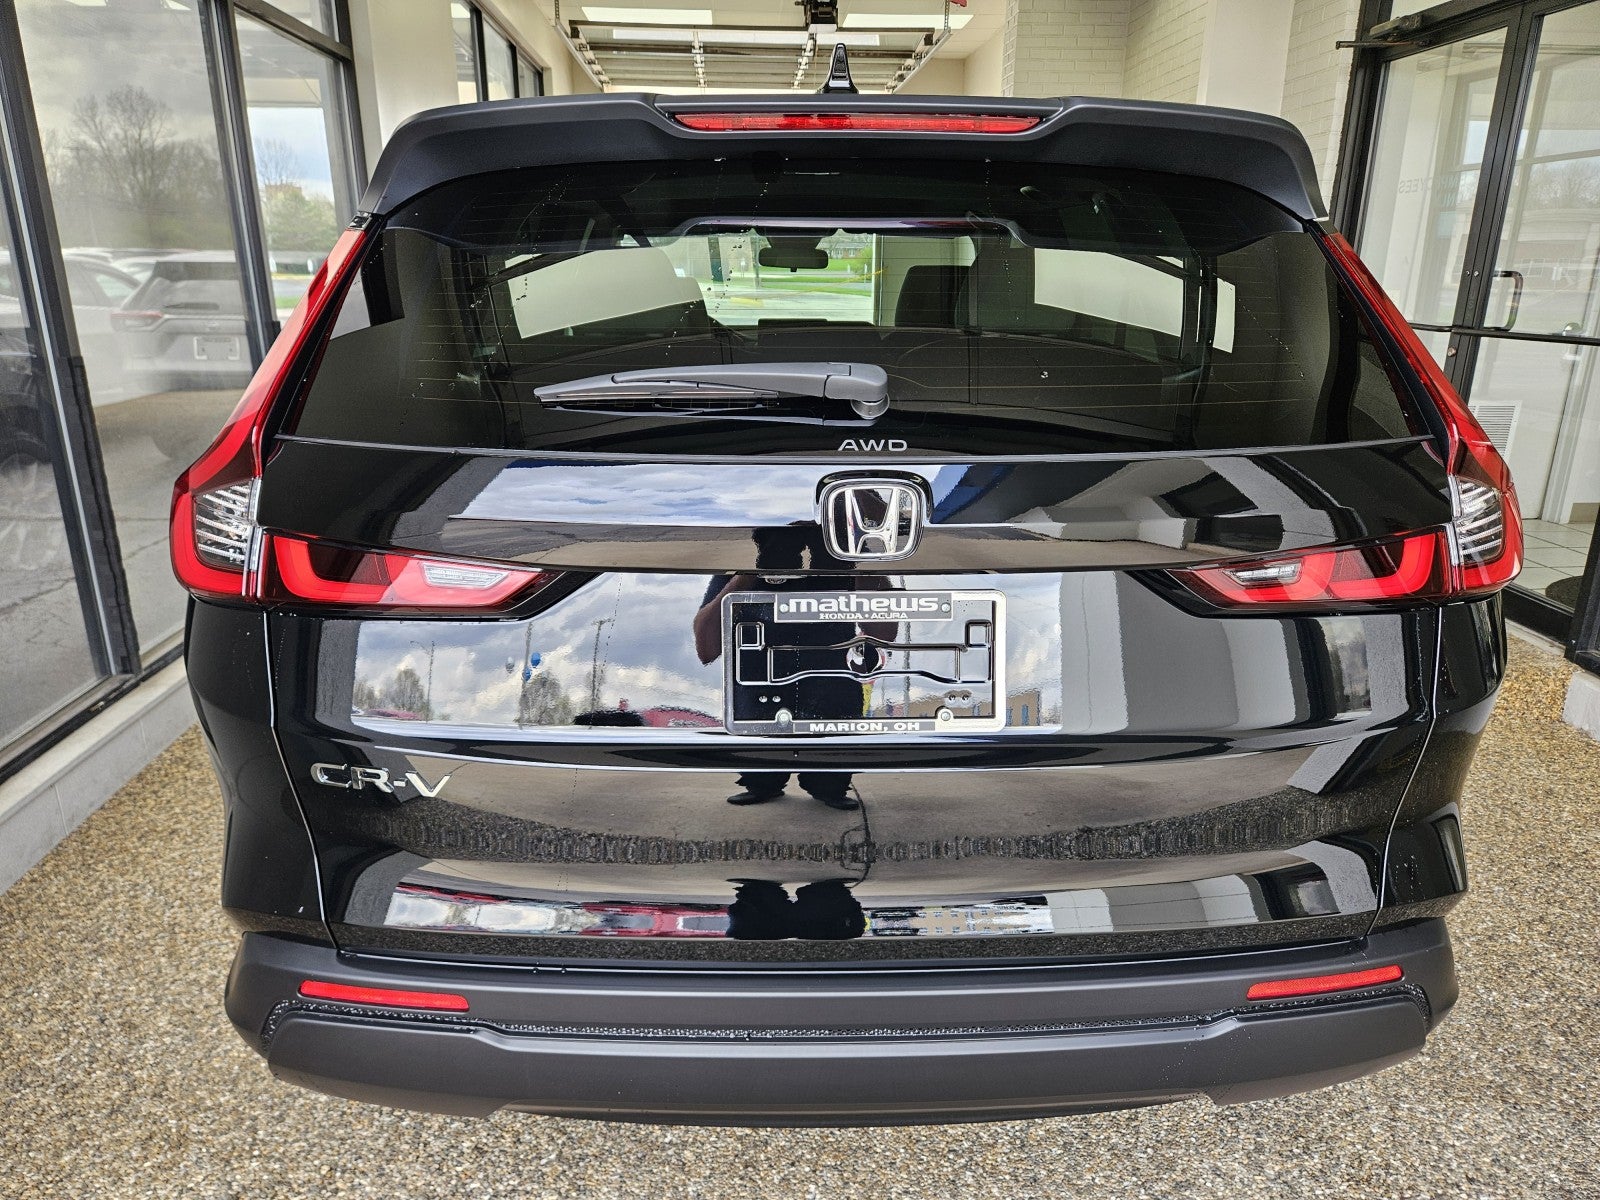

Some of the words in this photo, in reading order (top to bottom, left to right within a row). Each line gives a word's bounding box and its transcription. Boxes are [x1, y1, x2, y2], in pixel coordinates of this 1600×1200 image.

[837, 439, 908, 452] AWD
[789, 594, 939, 613] mathews
[819, 612, 864, 620] HONDA
[809, 722, 889, 732] MARION,
[893, 722, 920, 731] OH
[310, 762, 452, 798] CR-V
